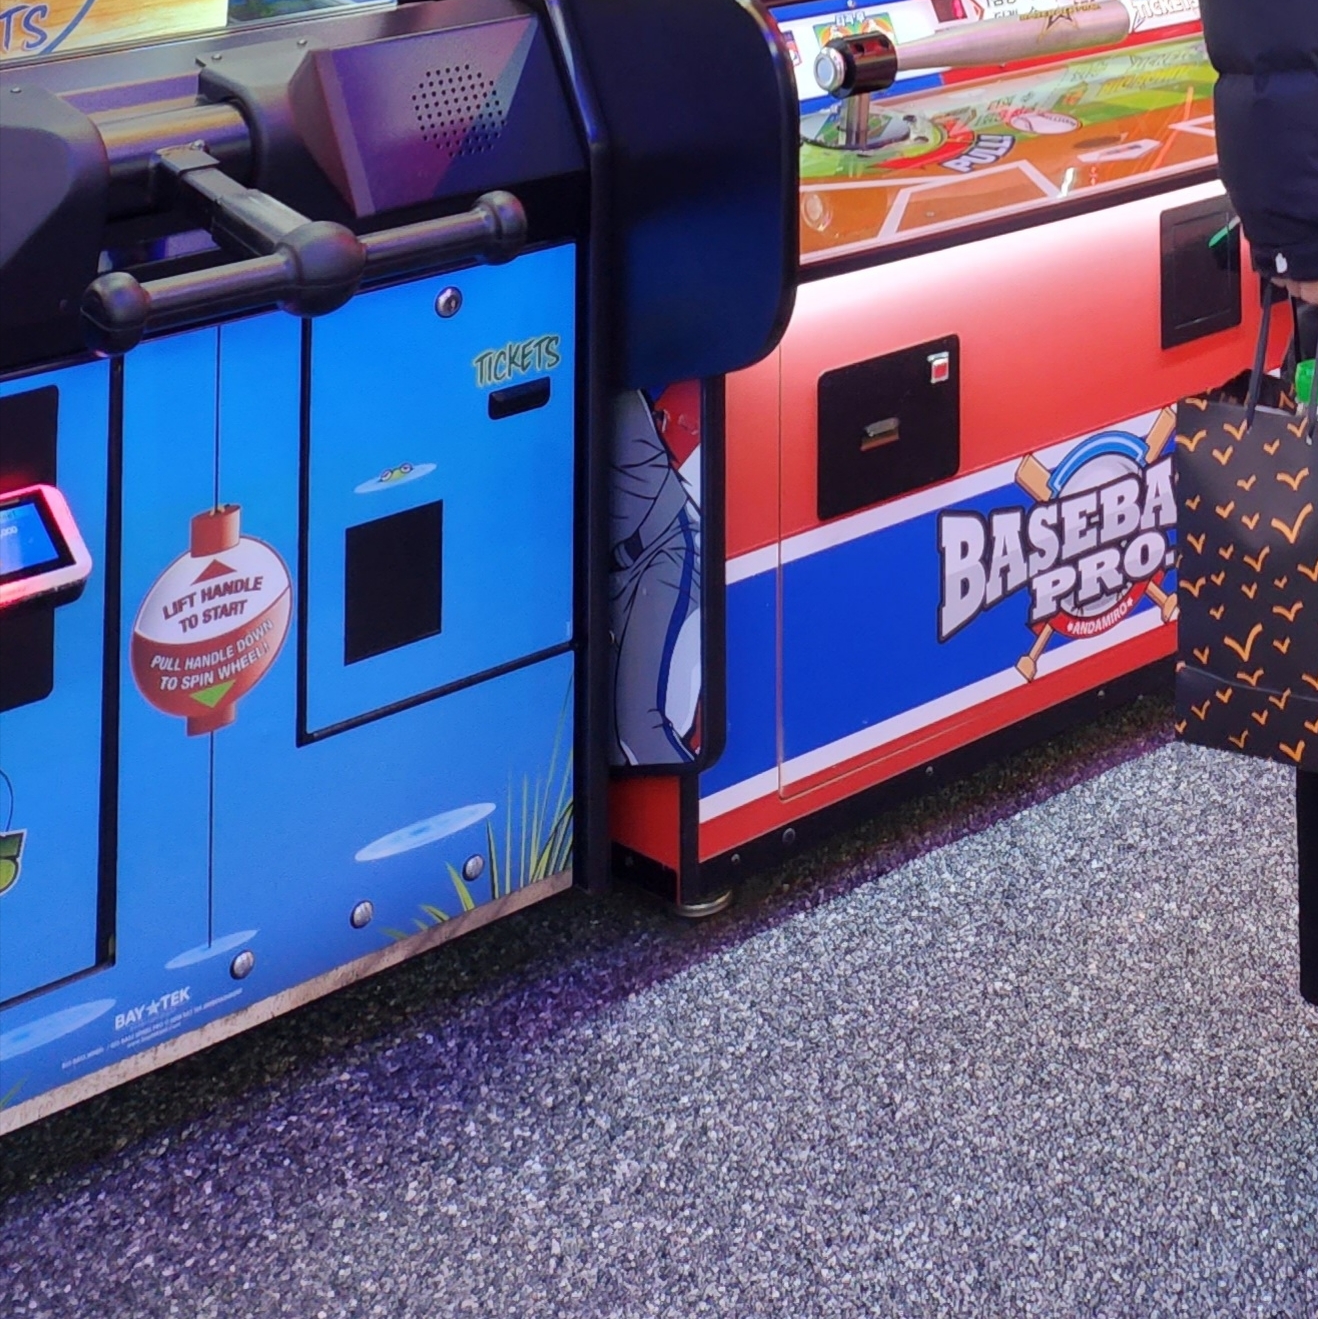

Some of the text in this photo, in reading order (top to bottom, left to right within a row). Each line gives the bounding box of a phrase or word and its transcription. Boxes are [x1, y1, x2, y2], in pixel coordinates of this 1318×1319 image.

[940, 133, 1017, 173] PULL
[474, 335, 561, 385] TICKETS
[939, 457, 1177, 640] BASEBA
[162, 575, 263, 620] LIFT HANDLE
[178, 599, 248, 633] TO START
[1071, 603, 1129, 635] ANDAMIRO
[150, 618, 274, 672] PULL HANDLE DOWN
[159, 640, 271, 691] TO SPIN WHEEL!
